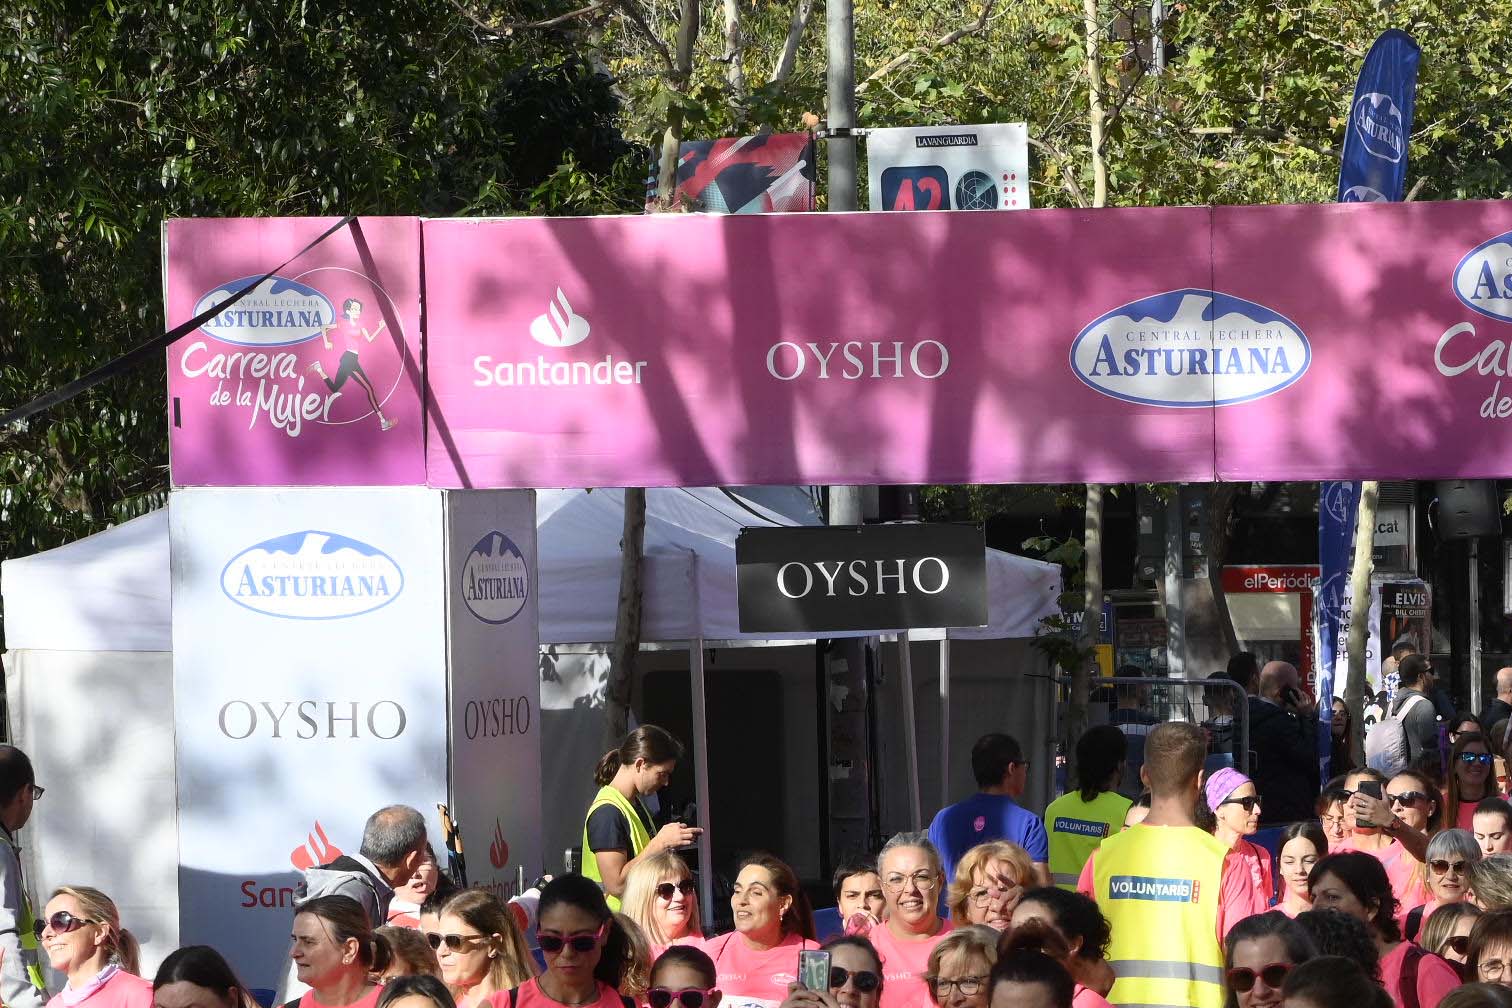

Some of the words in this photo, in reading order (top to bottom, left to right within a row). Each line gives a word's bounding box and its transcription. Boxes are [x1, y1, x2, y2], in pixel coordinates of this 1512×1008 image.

[928, 136, 977, 145] VANGUARDIA
[204, 301, 324, 328] ASTURIANA
[1126, 329, 1200, 342] CENTRAL
[1210, 328, 1284, 342] LECHERA
[181, 342, 297, 379] Carrera
[473, 352, 648, 386] Santander
[766, 340, 949, 380] OYSHO
[1089, 334, 1293, 377] ASTURIANA
[210, 380, 231, 406] de
[236, 378, 252, 406] la
[249, 375, 342, 437] Mujer
[235, 564, 391, 597] ASTURIANA
[467, 568, 525, 601] ASTURIANA
[776, 556, 950, 599] OYSHO
[1396, 592, 1426, 605] ELVIS
[218, 700, 407, 740] OYSHO
[465, 695, 530, 740] OYSHO
[1056, 820, 1103, 834] VOLUNTARIS
[1111, 880, 1189, 897] VOLUNTARIS
